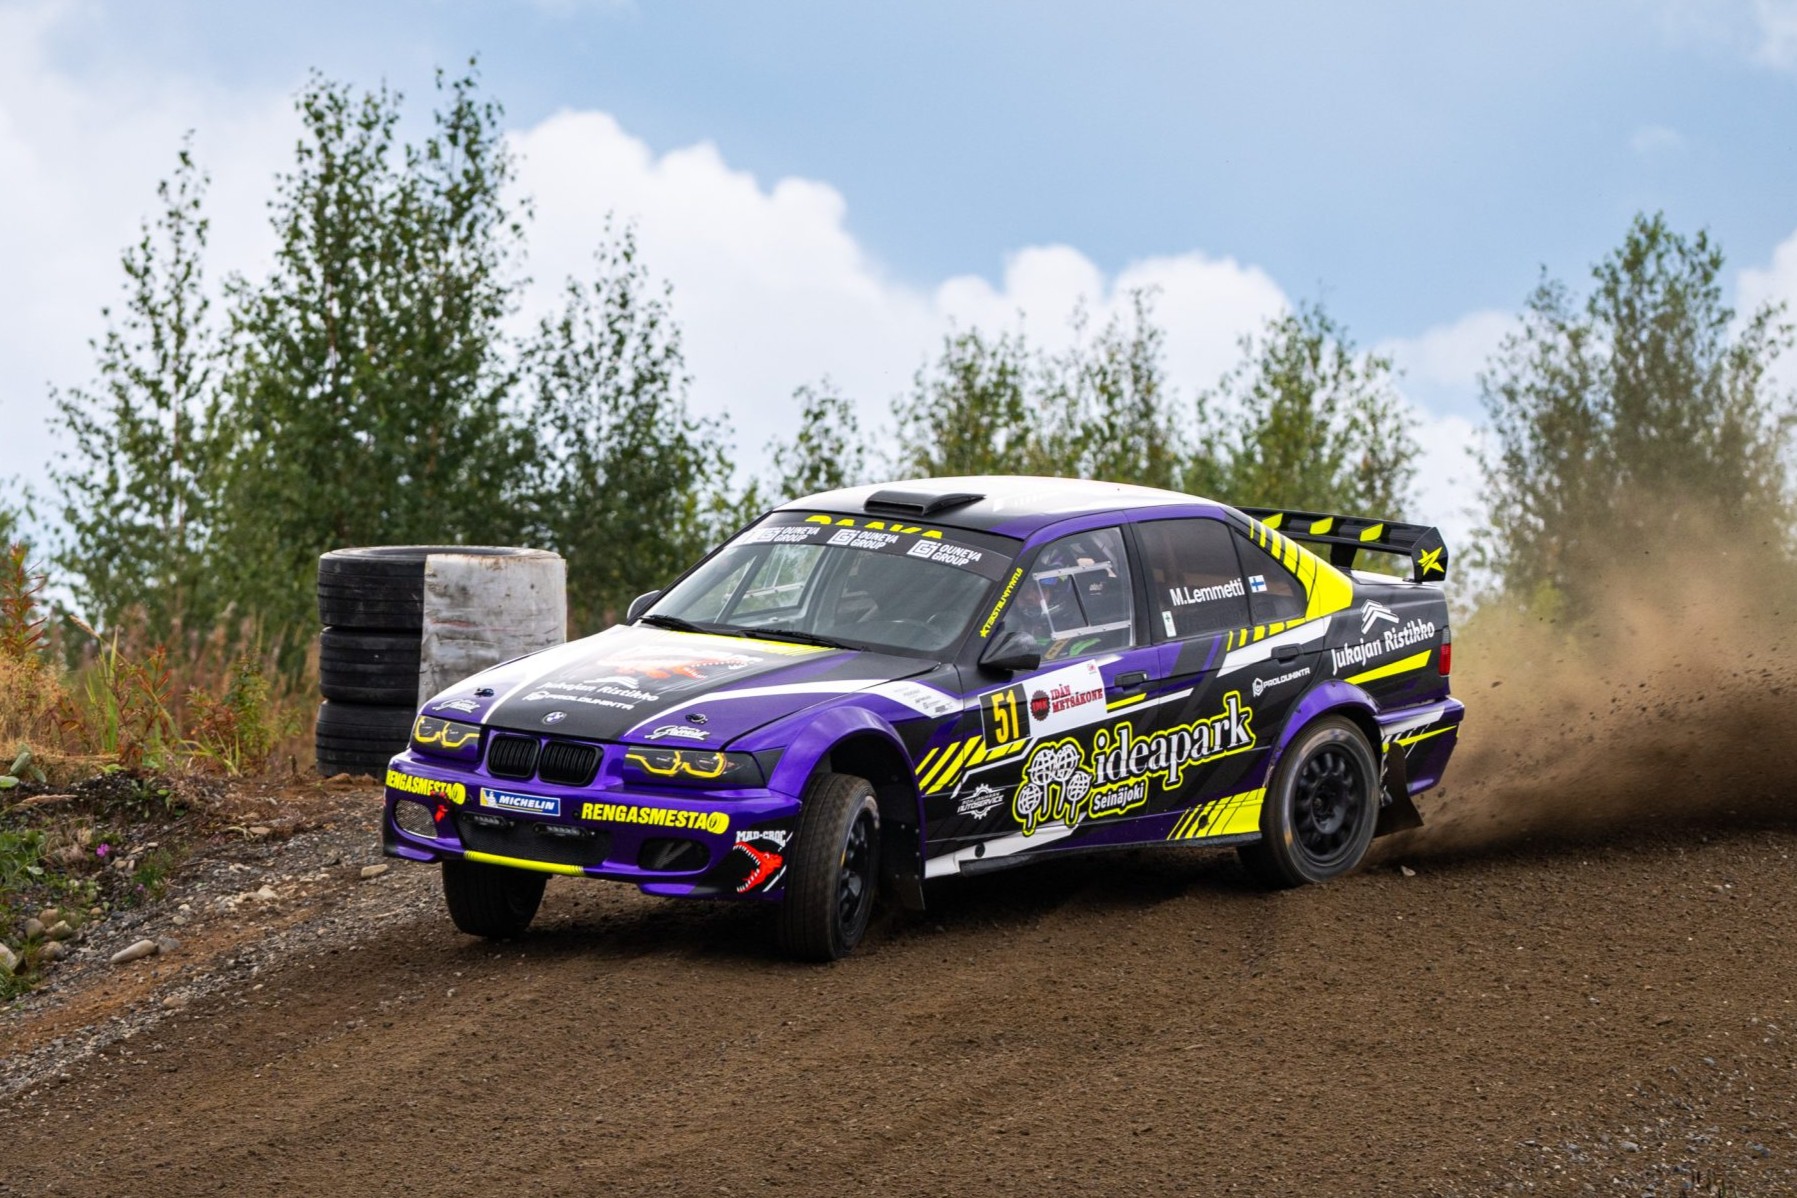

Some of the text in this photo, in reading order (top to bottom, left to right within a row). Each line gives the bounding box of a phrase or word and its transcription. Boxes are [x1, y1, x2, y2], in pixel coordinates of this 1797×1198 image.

[850, 538, 887, 550] GROUP
[858, 530, 900, 544] OUNEVA
[931, 551, 970, 567] GROUP
[939, 543, 983, 562] OUNEVA
[1169, 577, 1245, 606] M.Lemmetti
[1331, 618, 1435, 676] Jukajan Ristikko
[1263, 667, 1311, 689] PROLOUHINTA
[598, 682, 660, 702] Ristikko
[1050, 684, 1071, 701] IDÄN
[1052, 688, 1103, 713] METSÄKONE
[991, 689, 1020, 744] 51
[1094, 697, 1251, 785] ideapark
[499, 794, 555, 810] MICHELIN
[1093, 782, 1144, 811] Seinäjoki
[735, 830, 786, 848] MAD-CROC
